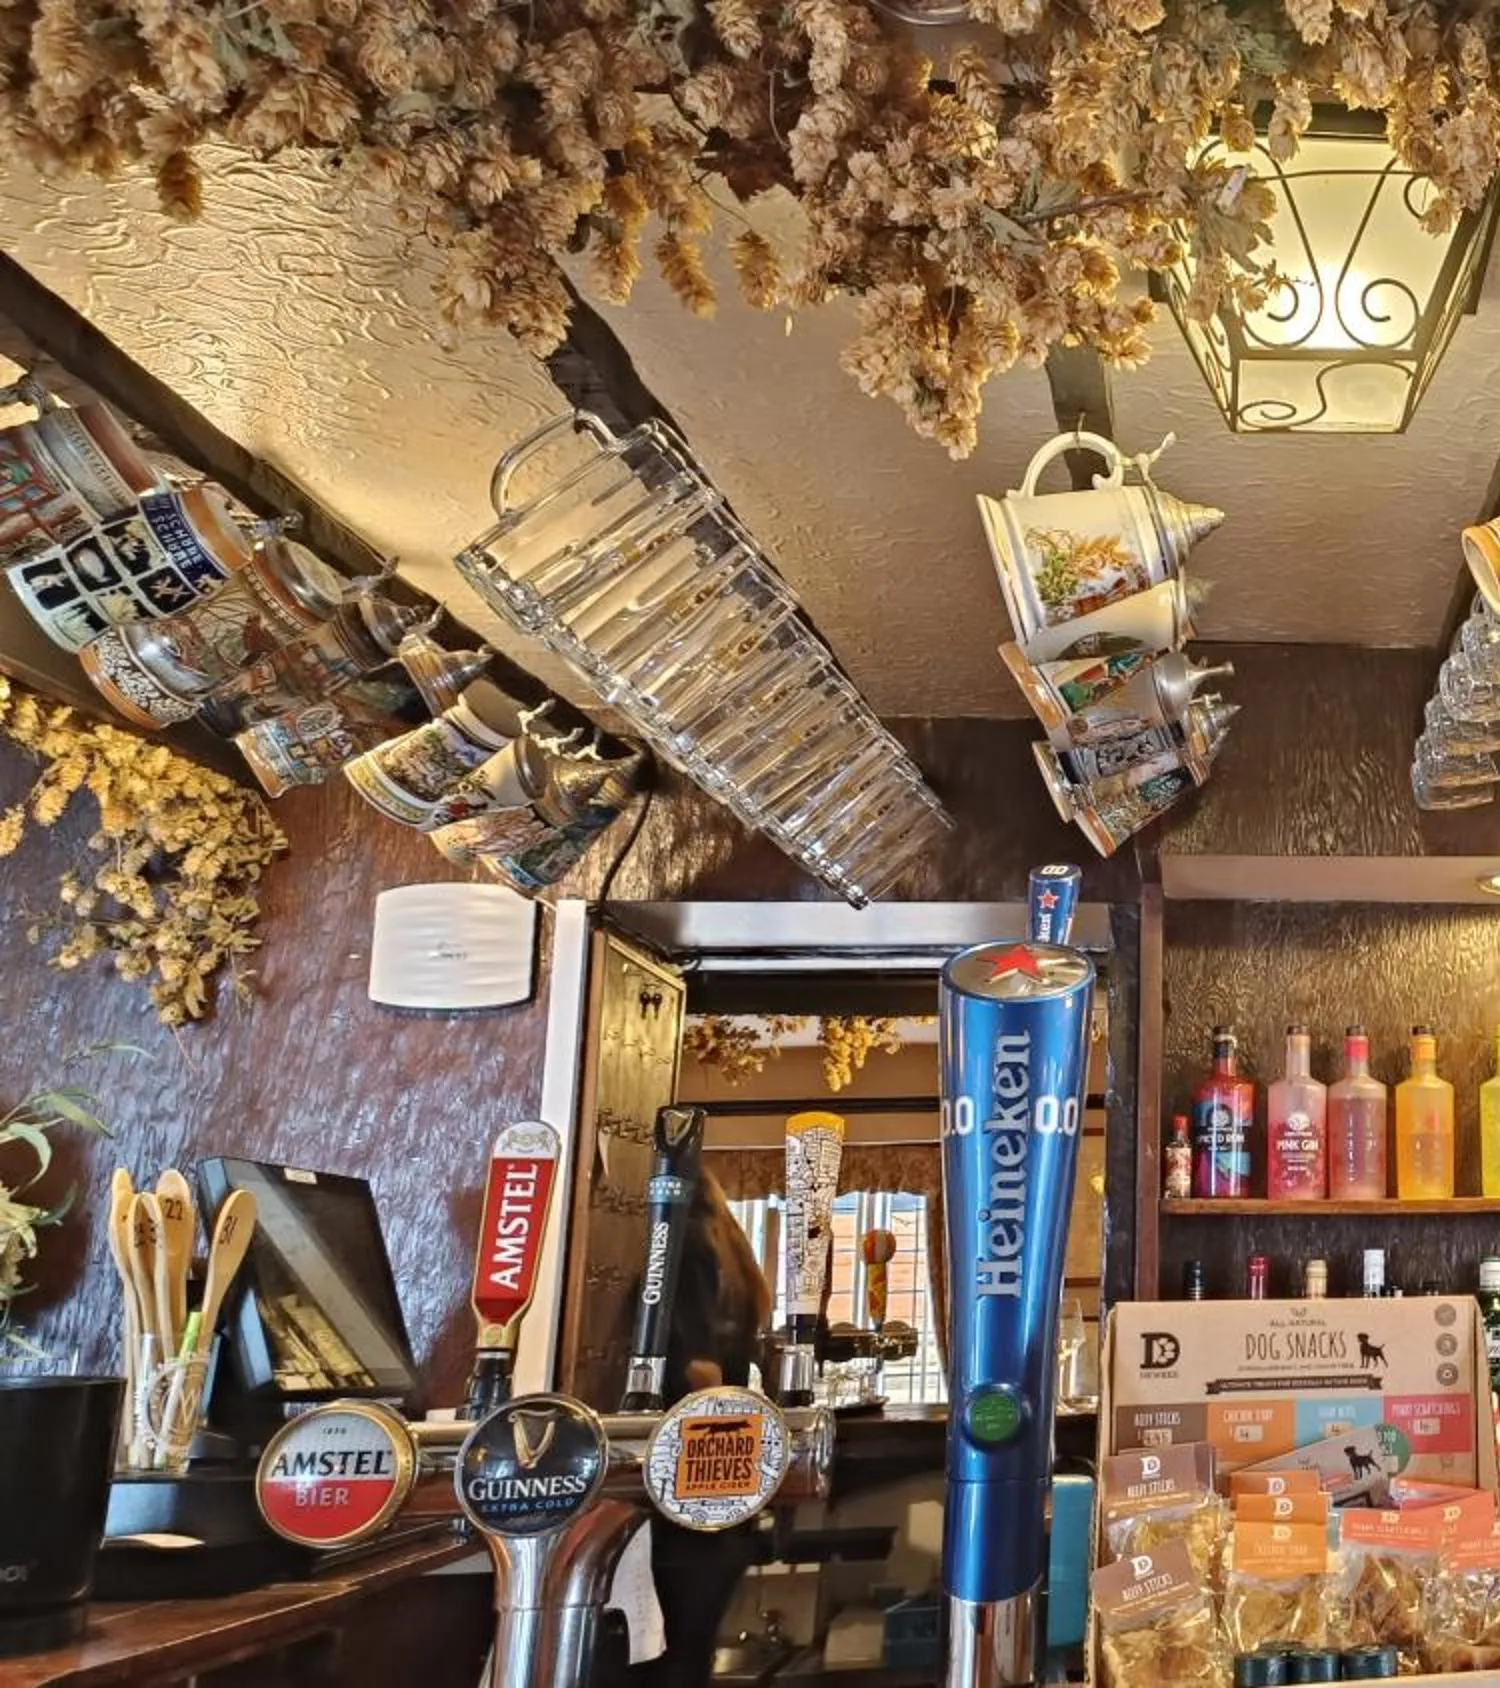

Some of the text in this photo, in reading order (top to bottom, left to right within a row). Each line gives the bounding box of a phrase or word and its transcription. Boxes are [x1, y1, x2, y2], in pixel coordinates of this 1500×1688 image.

[1035, 1095, 1080, 1136] 0.0
[975, 1029, 1032, 1300] Heineken
[490, 1163, 539, 1290] AMSTEL
[642, 1220, 670, 1305] GUINNESS
[1246, 1331, 1347, 1361] DOG SNACKS
[687, 1435, 755, 1458] ORCHARD
[271, 1451, 392, 1477] AMSTEL
[686, 1458, 753, 1482] THIEVES
[294, 1487, 350, 1507] BIER
[468, 1475, 587, 1501] GUINNESS
[482, 1498, 576, 1513] EXTRA COLD
